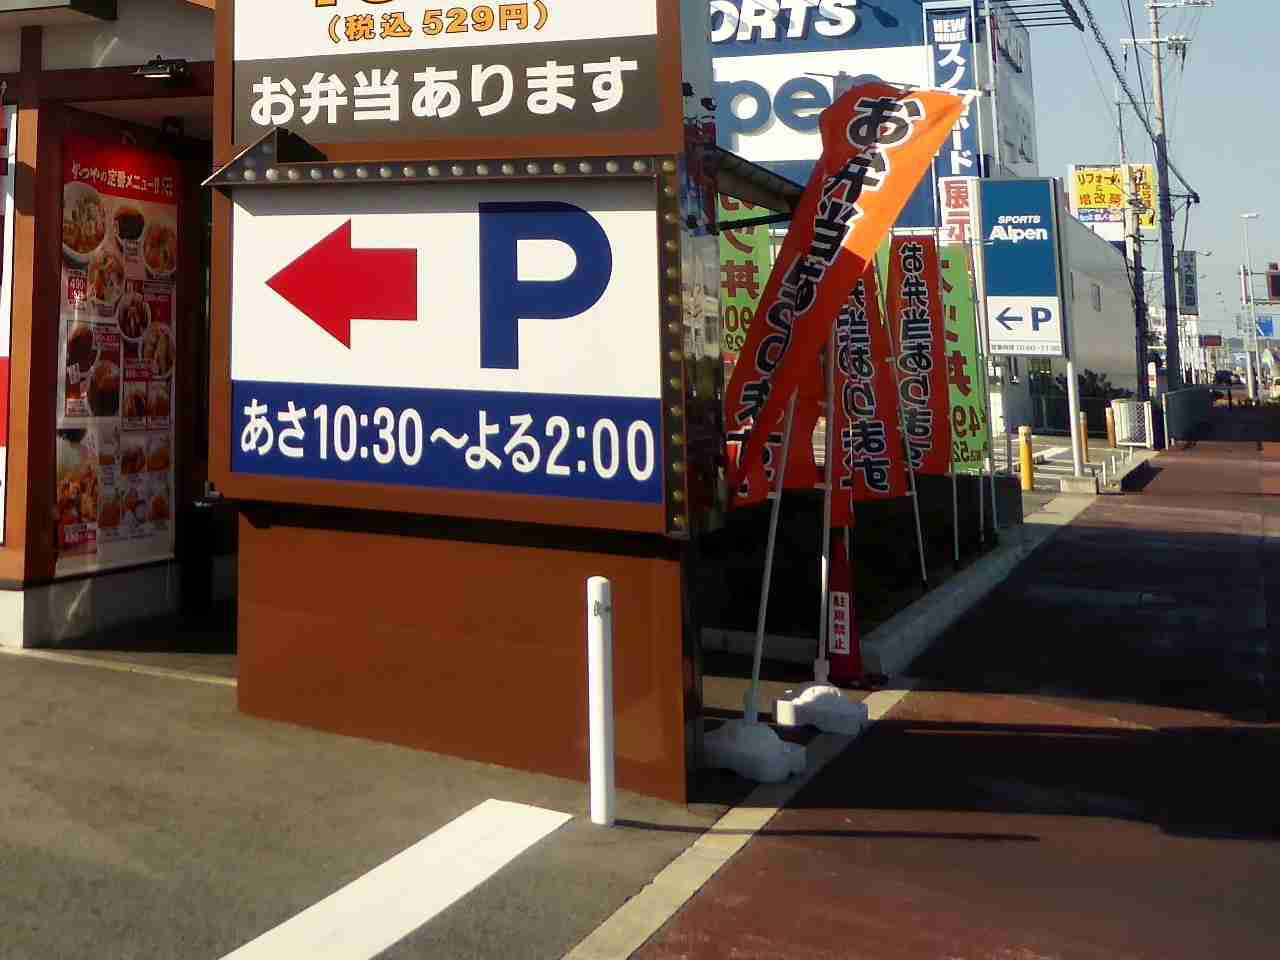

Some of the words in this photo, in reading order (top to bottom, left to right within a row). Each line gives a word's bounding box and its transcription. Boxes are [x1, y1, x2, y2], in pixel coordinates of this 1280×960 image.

[250, 56, 639, 127] お弁当あります
[997, 215, 1041, 224] SPORTS
[989, 225, 1048, 243] Alpen
[478, 201, 613, 369] P
[1031, 306, 1052, 331] P
